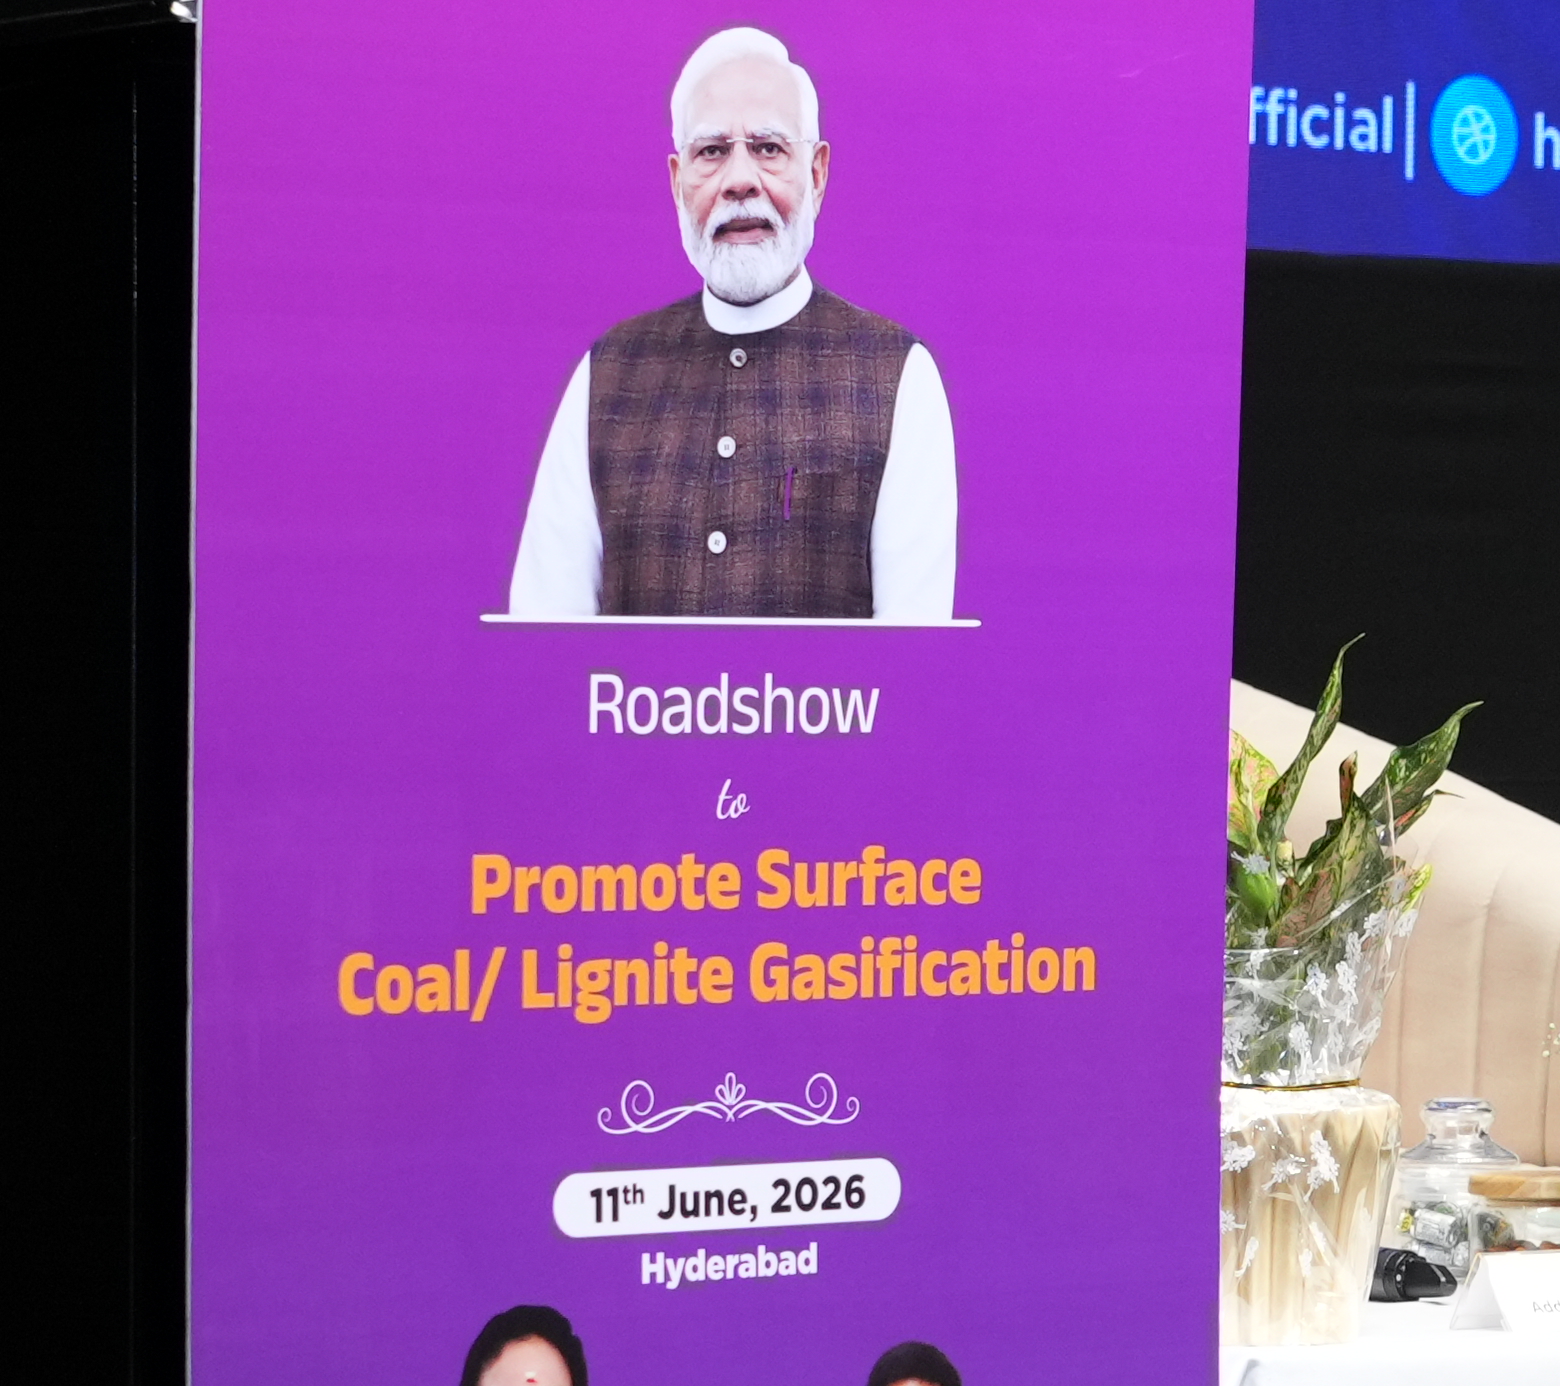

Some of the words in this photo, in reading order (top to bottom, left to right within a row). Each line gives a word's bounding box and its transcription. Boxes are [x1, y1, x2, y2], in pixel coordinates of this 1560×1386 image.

[1248, 85, 1393, 154] fficial
[587, 671, 880, 735] Roadshow
[715, 779, 750, 820] to
[471, 852, 741, 914] Promote
[755, 845, 983, 910] Surface
[338, 946, 505, 1023] Coal/
[522, 942, 735, 1025] Lignite
[749, 933, 1098, 1002] Gasification
[589, 1183, 646, 1224] 11th
[656, 1178, 760, 1225] June,
[771, 1175, 867, 1215] 2026
[640, 1243, 819, 1291] Hyderabad
